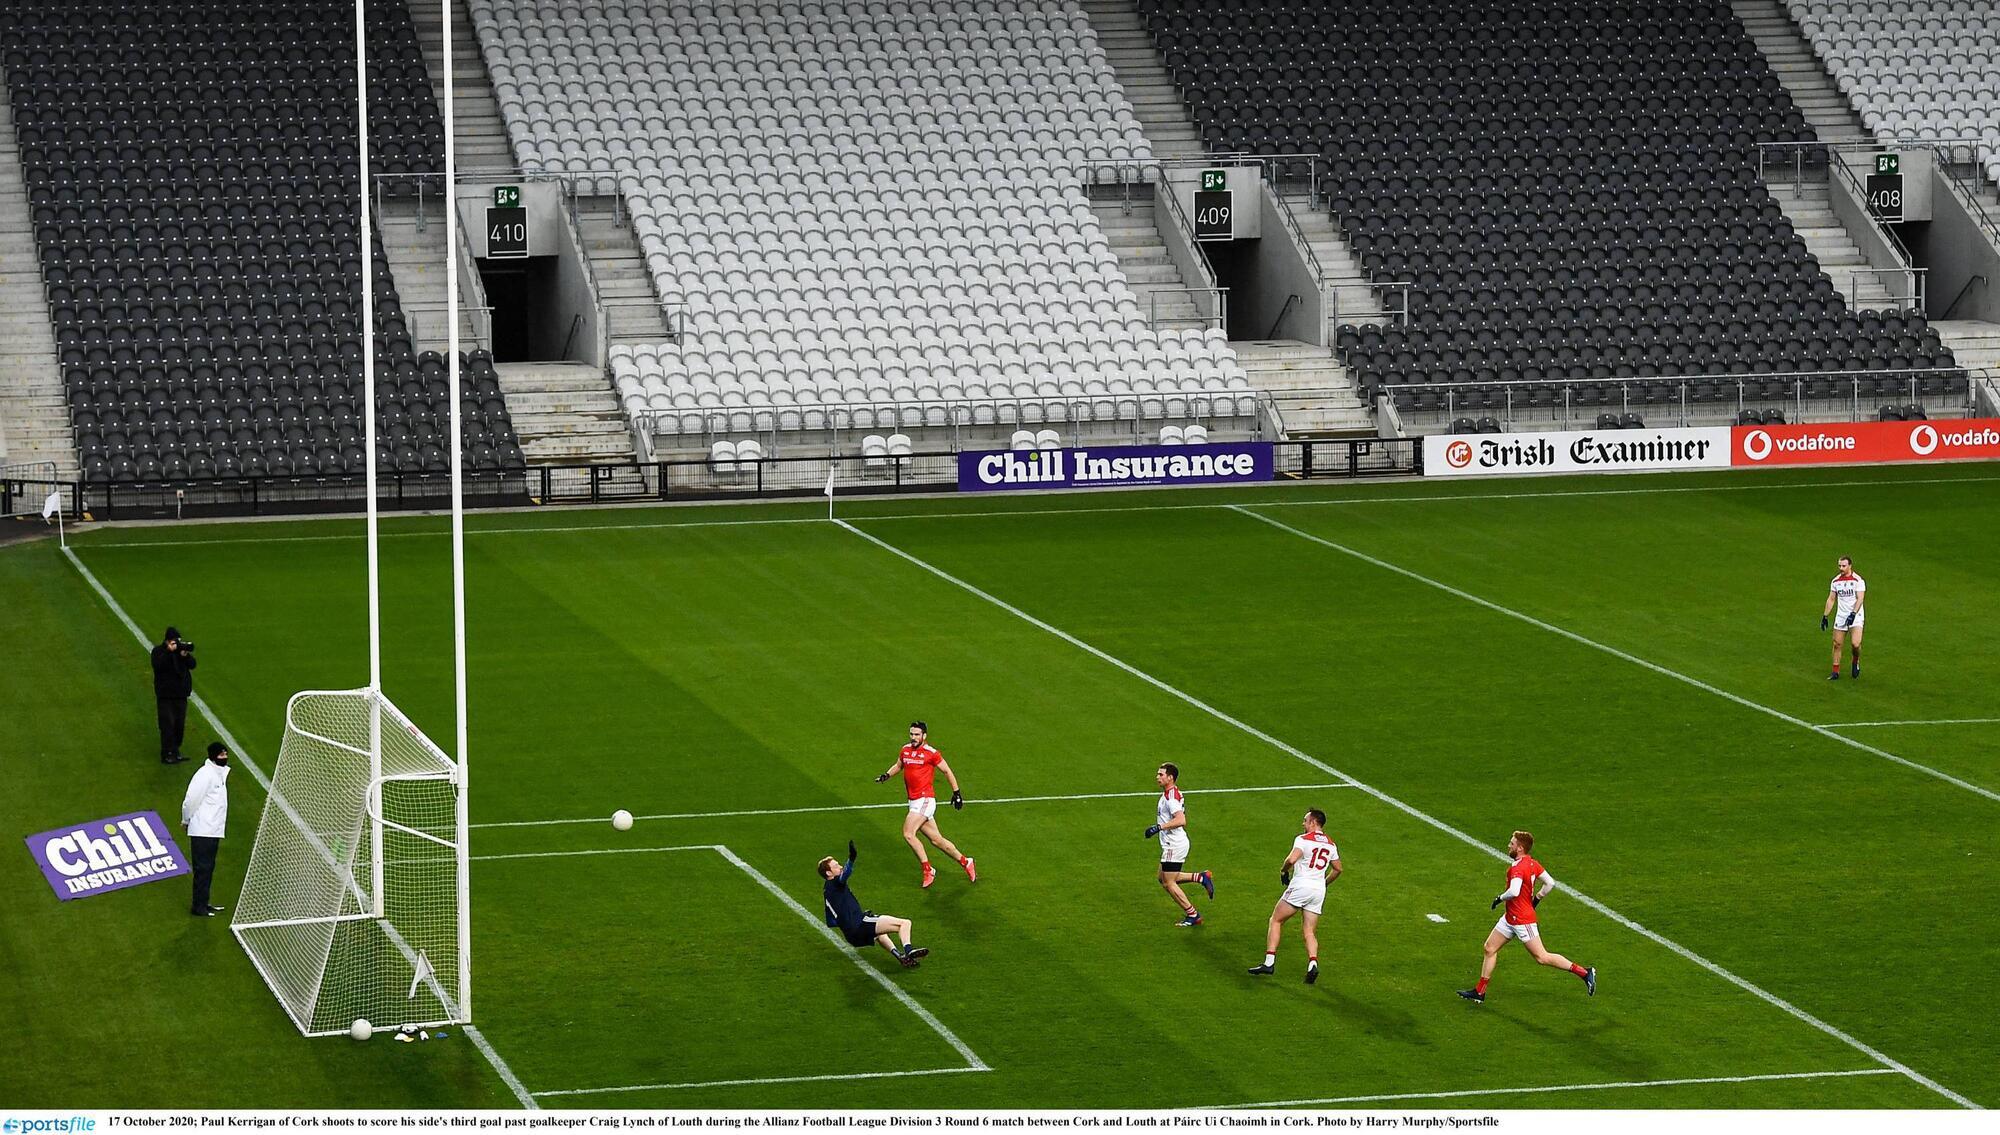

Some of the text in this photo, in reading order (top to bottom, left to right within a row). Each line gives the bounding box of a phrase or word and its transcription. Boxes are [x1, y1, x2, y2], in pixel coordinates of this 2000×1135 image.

[1870, 190, 1901, 208] 408
[1197, 207, 1230, 225] 409
[490, 223, 525, 242] 410
[1479, 434, 1710, 467] Irish Examiner
[1776, 433, 1855, 451] vodafone
[978, 450, 1254, 484] Chill Insurance
[45, 816, 168, 877] Chill
[1309, 847, 1330, 870] 15
[64, 855, 178, 894] INSURANCE
